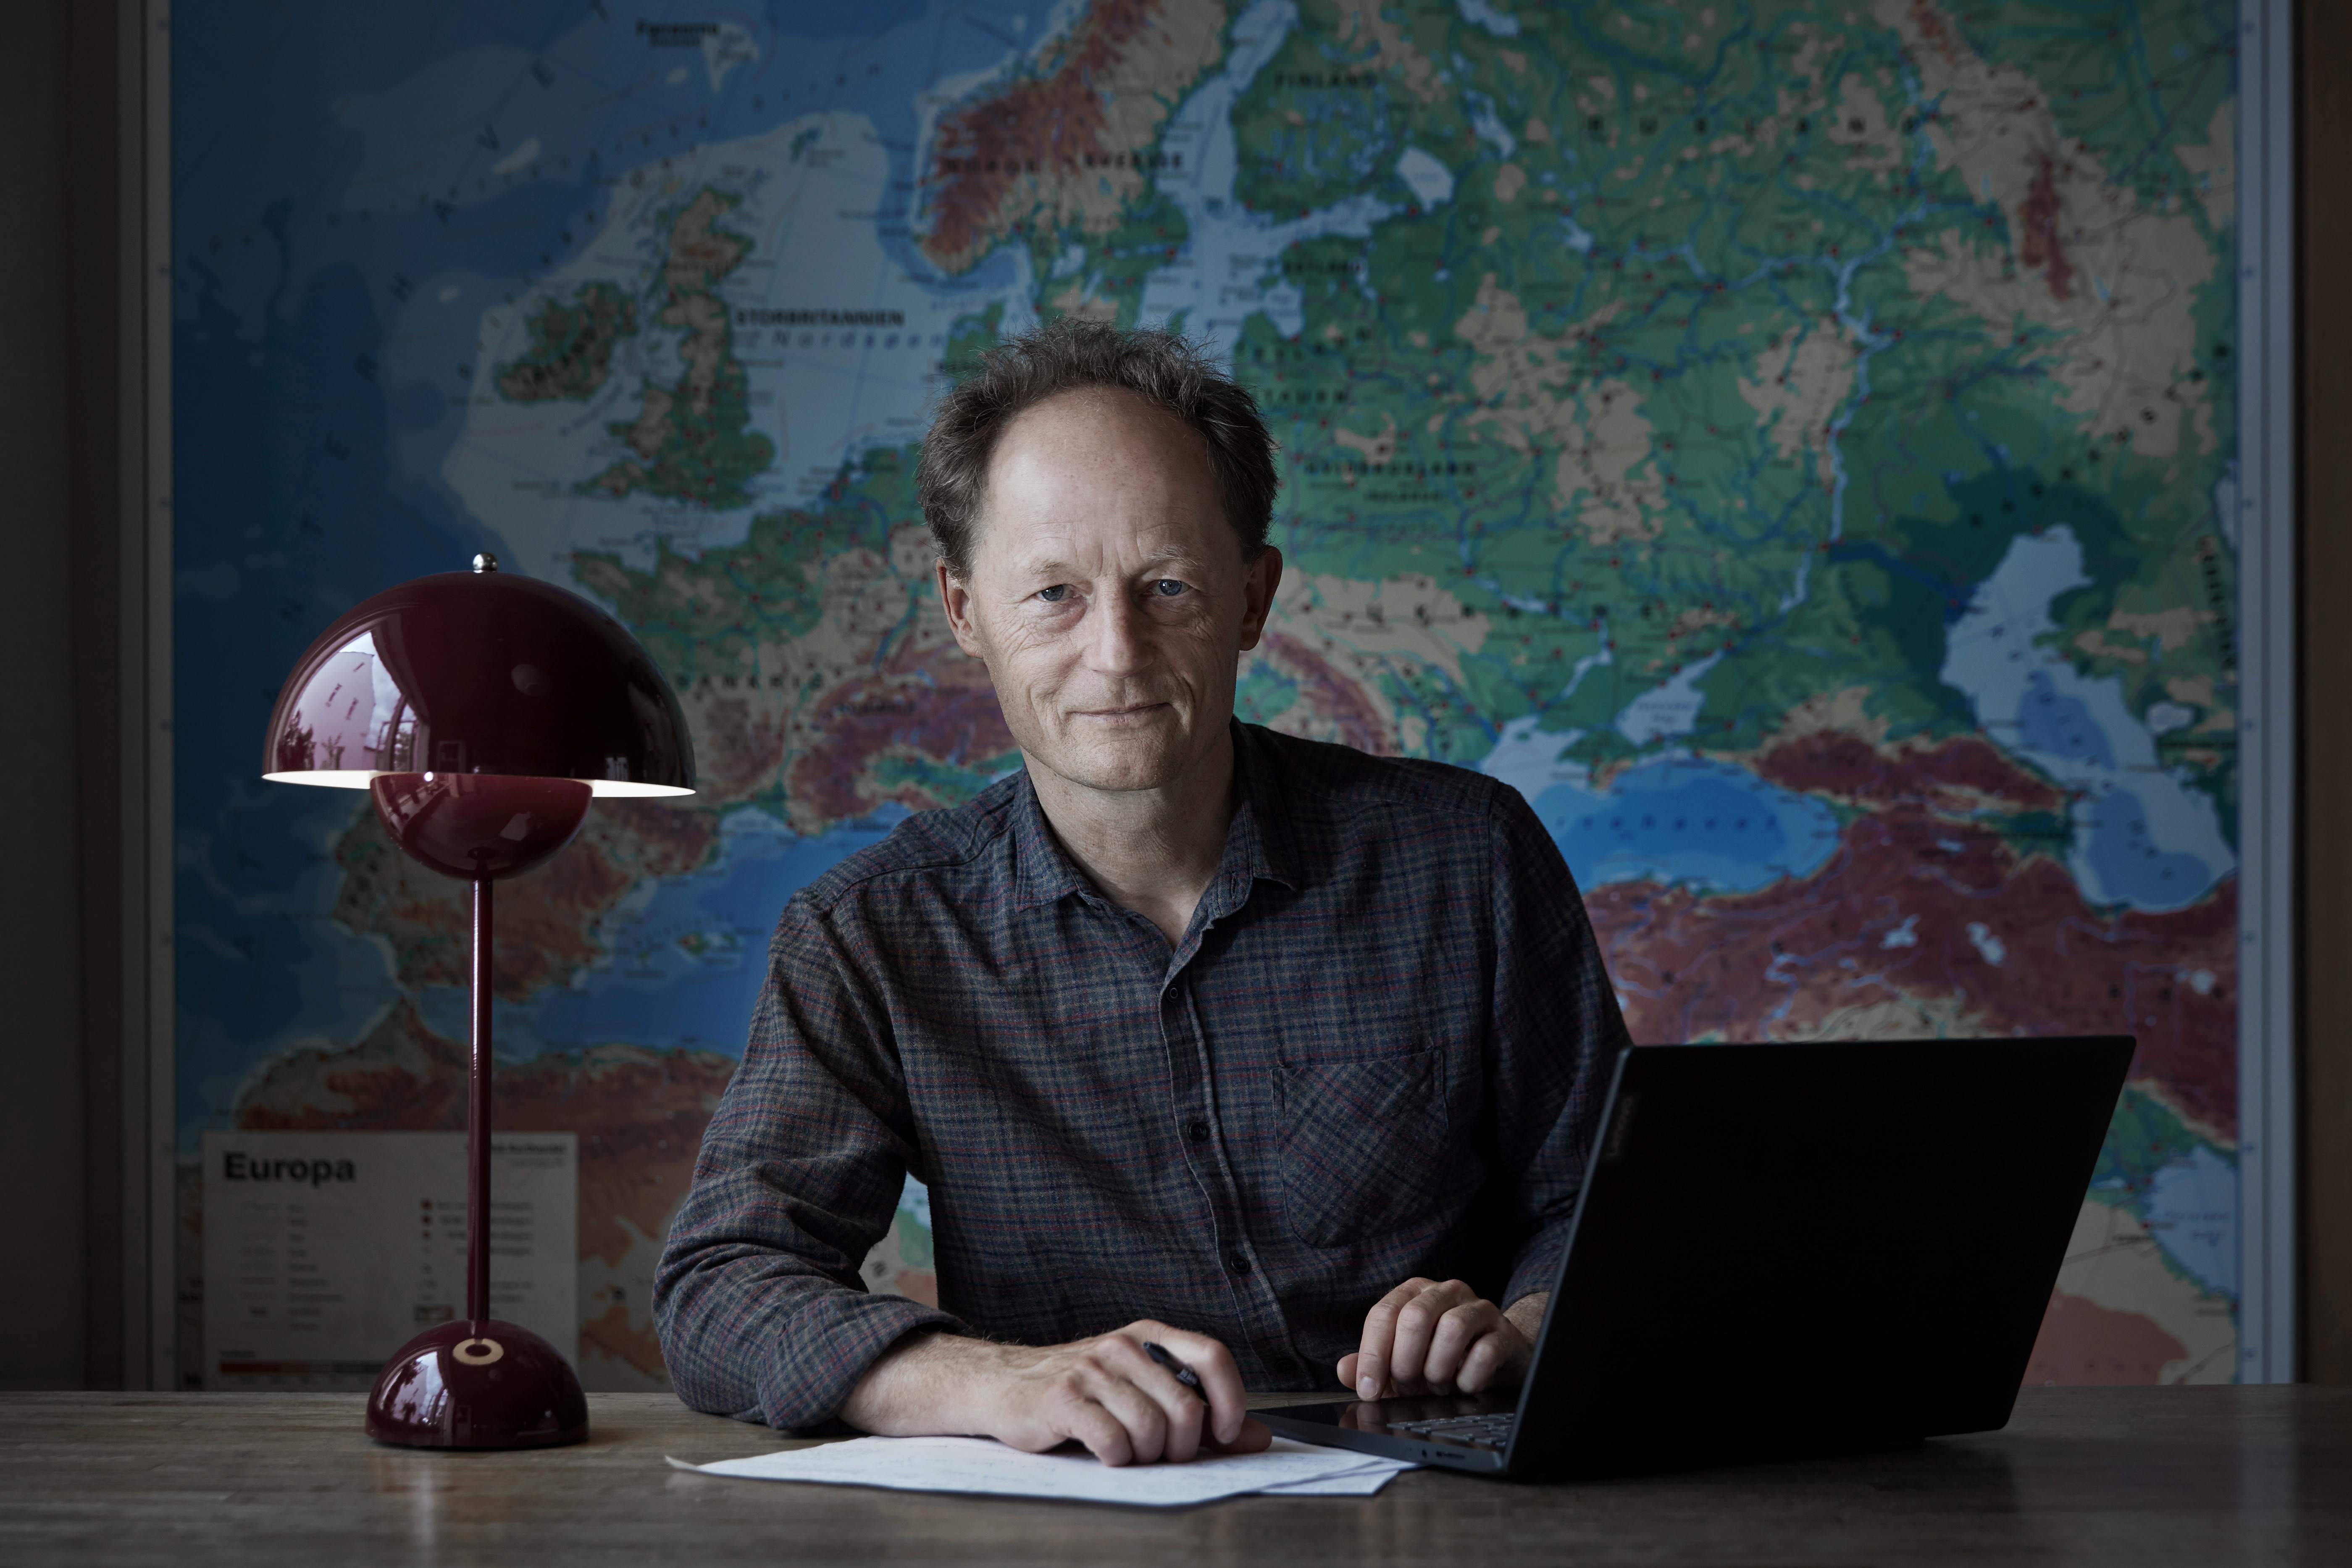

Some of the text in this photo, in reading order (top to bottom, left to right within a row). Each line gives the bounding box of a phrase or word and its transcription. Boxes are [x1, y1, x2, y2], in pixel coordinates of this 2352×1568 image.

[1275, 72, 1377, 88] FINLAND
[1084, 153, 1184, 168] SVERIGE
[736, 310, 904, 326] STORBRITANNIEN
[773, 329, 943, 347] Nordsøen
[675, 673, 824, 691] RANKRIG
[223, 1151, 356, 1188] Europa
